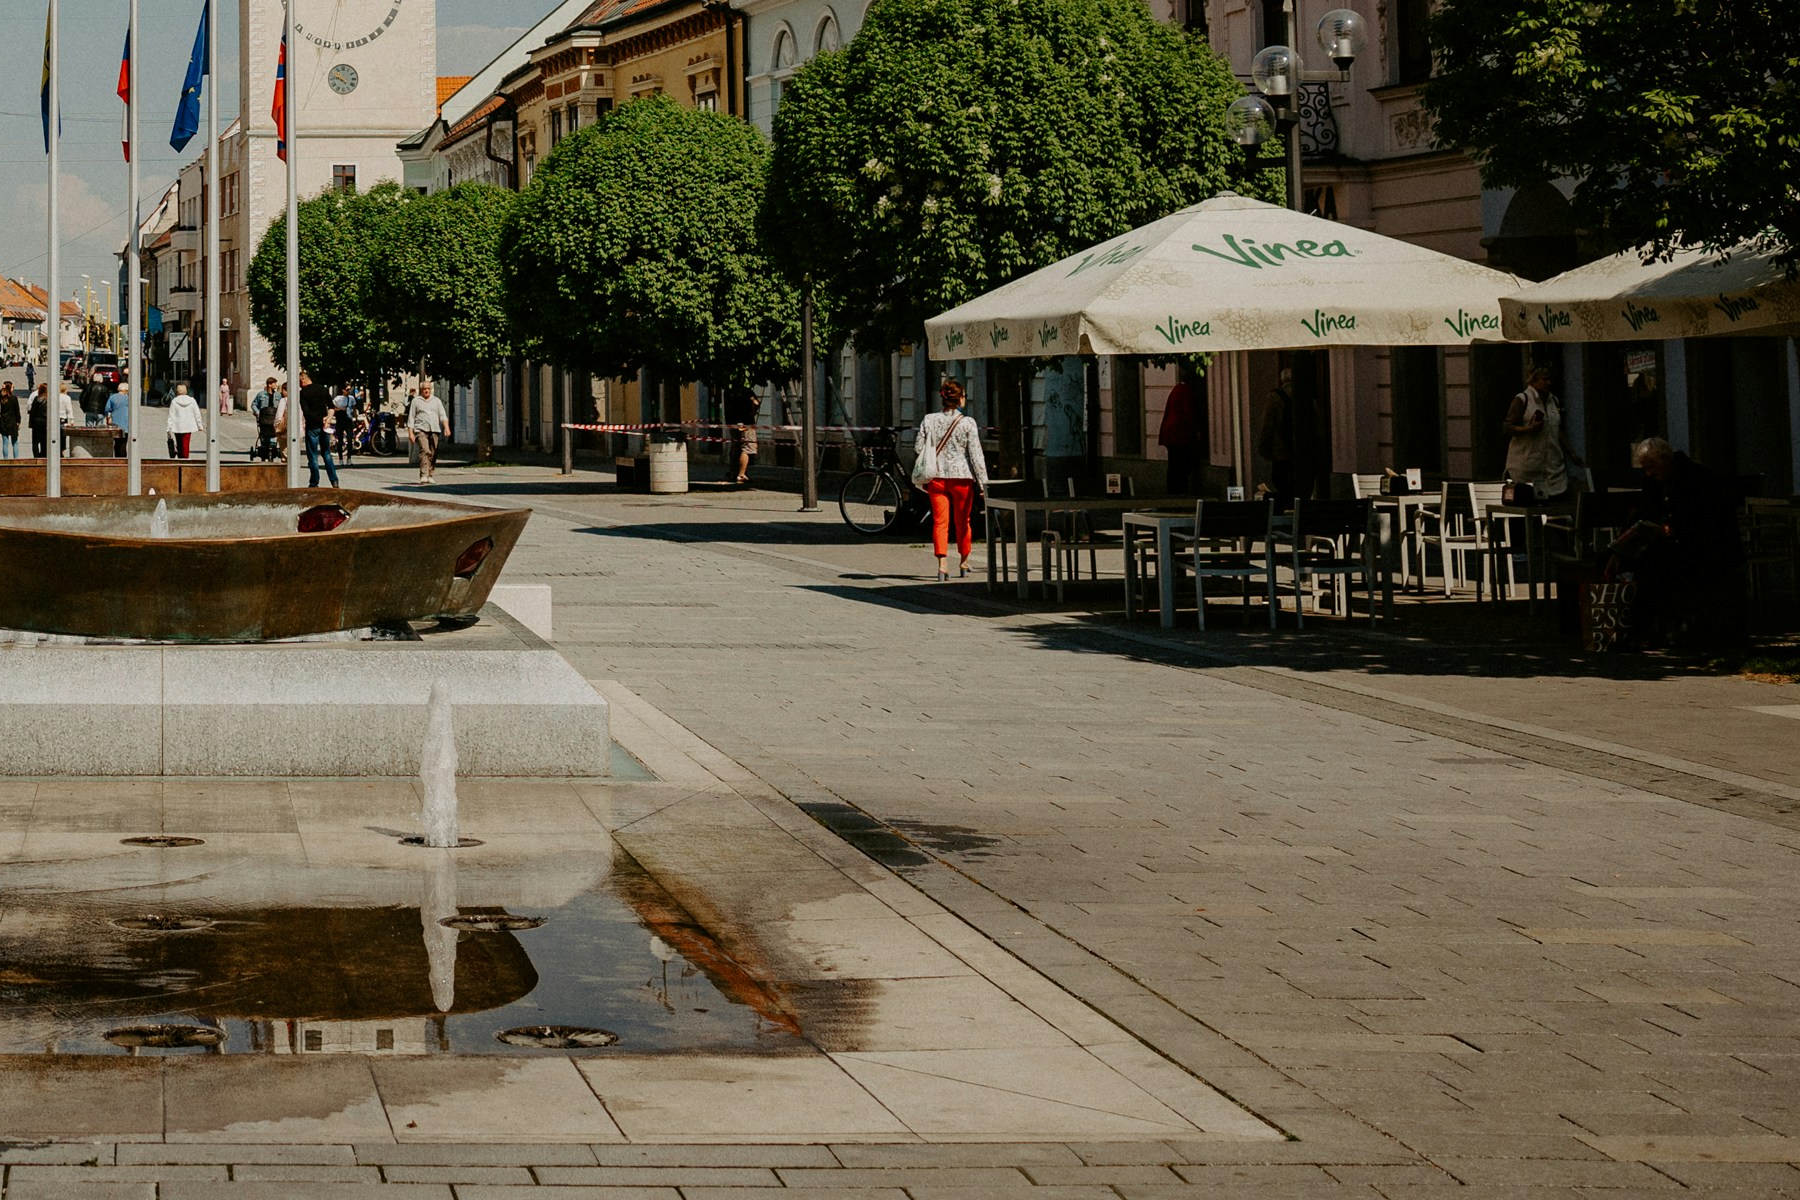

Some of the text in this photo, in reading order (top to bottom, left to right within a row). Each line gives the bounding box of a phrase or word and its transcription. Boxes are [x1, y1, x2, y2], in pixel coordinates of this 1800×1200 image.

[1192, 233, 1356, 269] Vinea
[1538, 304, 1570, 335] Vinea
[1621, 300, 1660, 332] Vinea
[1716, 292, 1759, 322] Vinea
[989, 321, 1009, 349] Vinea
[1038, 320, 1058, 349] Vinea
[1155, 315, 1212, 345] Vinea
[1301, 308, 1356, 338] Vinea
[1444, 308, 1500, 338] Vinea
[945, 326, 964, 352] Vinea
